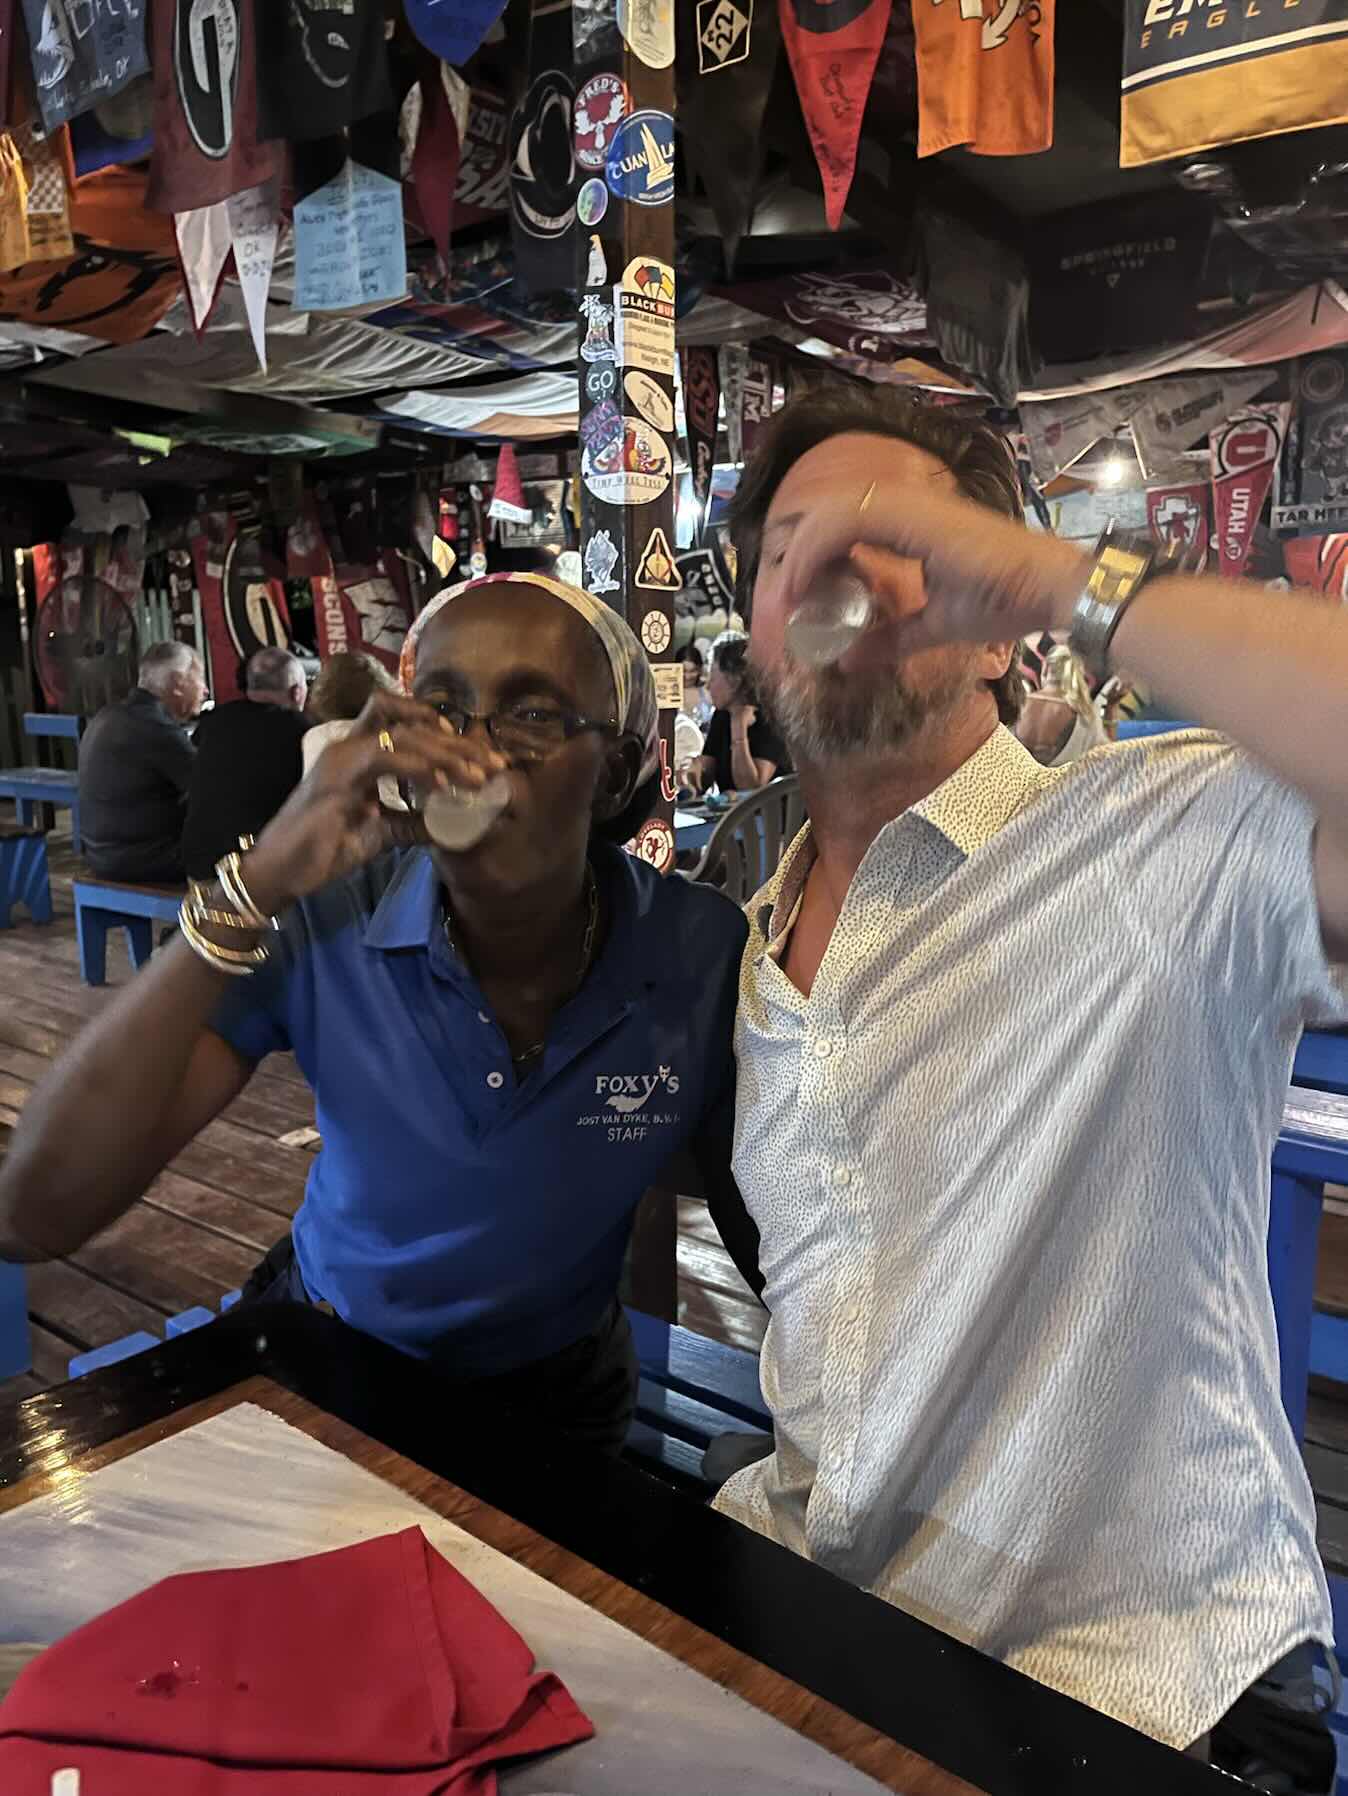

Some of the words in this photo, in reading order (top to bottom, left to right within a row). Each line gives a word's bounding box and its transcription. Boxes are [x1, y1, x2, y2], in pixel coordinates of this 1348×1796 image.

[715, 9, 734, 50] 22
[1228, 488, 1251, 533] UTAH
[1277, 510, 1309, 522] TAR
[577, 1116, 600, 1126] JOST
[602, 1114, 620, 1124] VAN
[608, 1128, 647, 1141] STAFF
